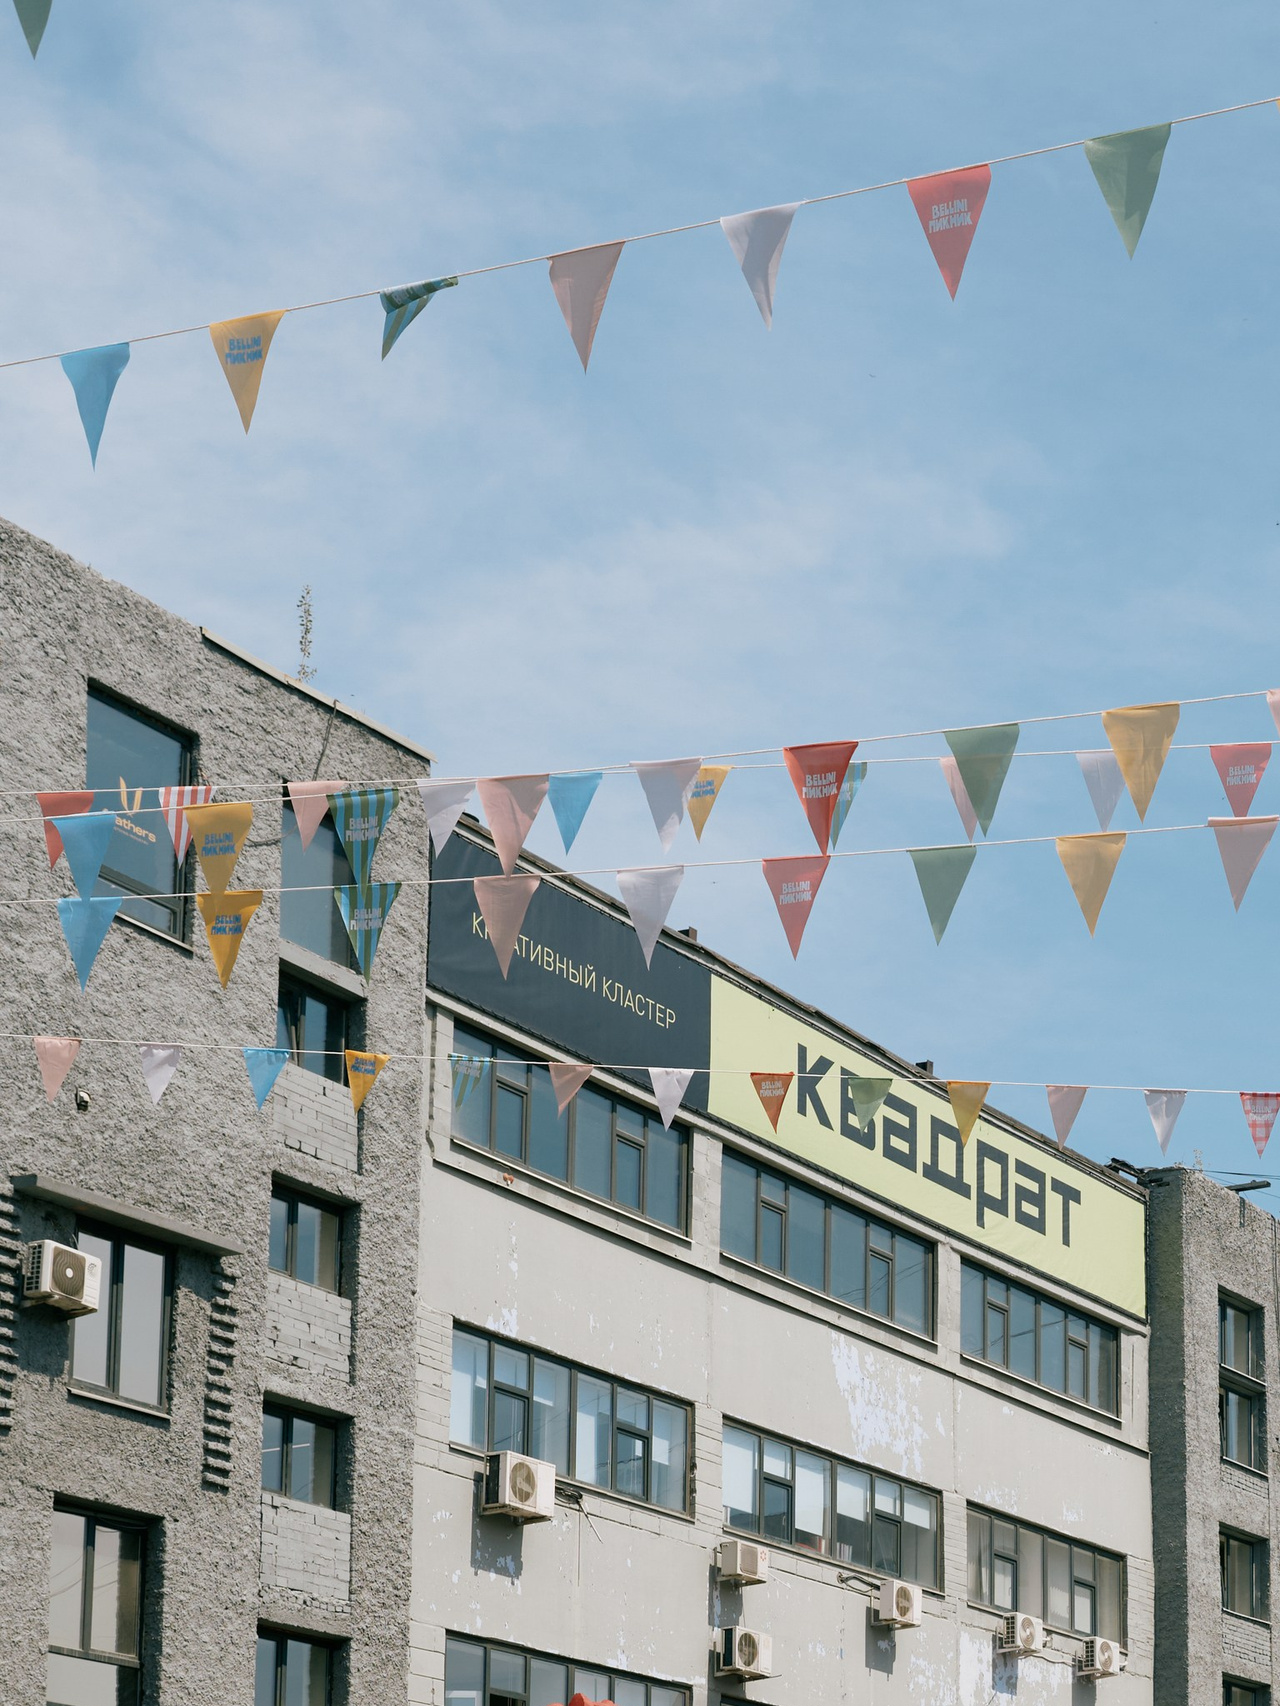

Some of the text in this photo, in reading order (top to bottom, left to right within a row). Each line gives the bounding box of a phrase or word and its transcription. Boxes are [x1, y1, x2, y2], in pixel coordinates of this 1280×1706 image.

[932, 199, 968, 220] BELLINI
[928, 212, 973, 234] ПИКНИК
[229, 336, 262, 351] BELLINI
[226, 348, 263, 364] ПИКНИК
[1229, 765, 1255, 776] BELLINI
[806, 772, 836, 786] BELLINI
[802, 782, 838, 798] ПИКНИК
[350, 816, 379, 829] BELLINI
[205, 832, 234, 846] BELLINI
[782, 880, 810, 894] BELLINI
[215, 914, 242, 925] BELLINI
[354, 908, 382, 920] BELLINI
[602, 976, 676, 1029] КЛАСТЕР
[762, 1080, 782, 1090] BELLINI
